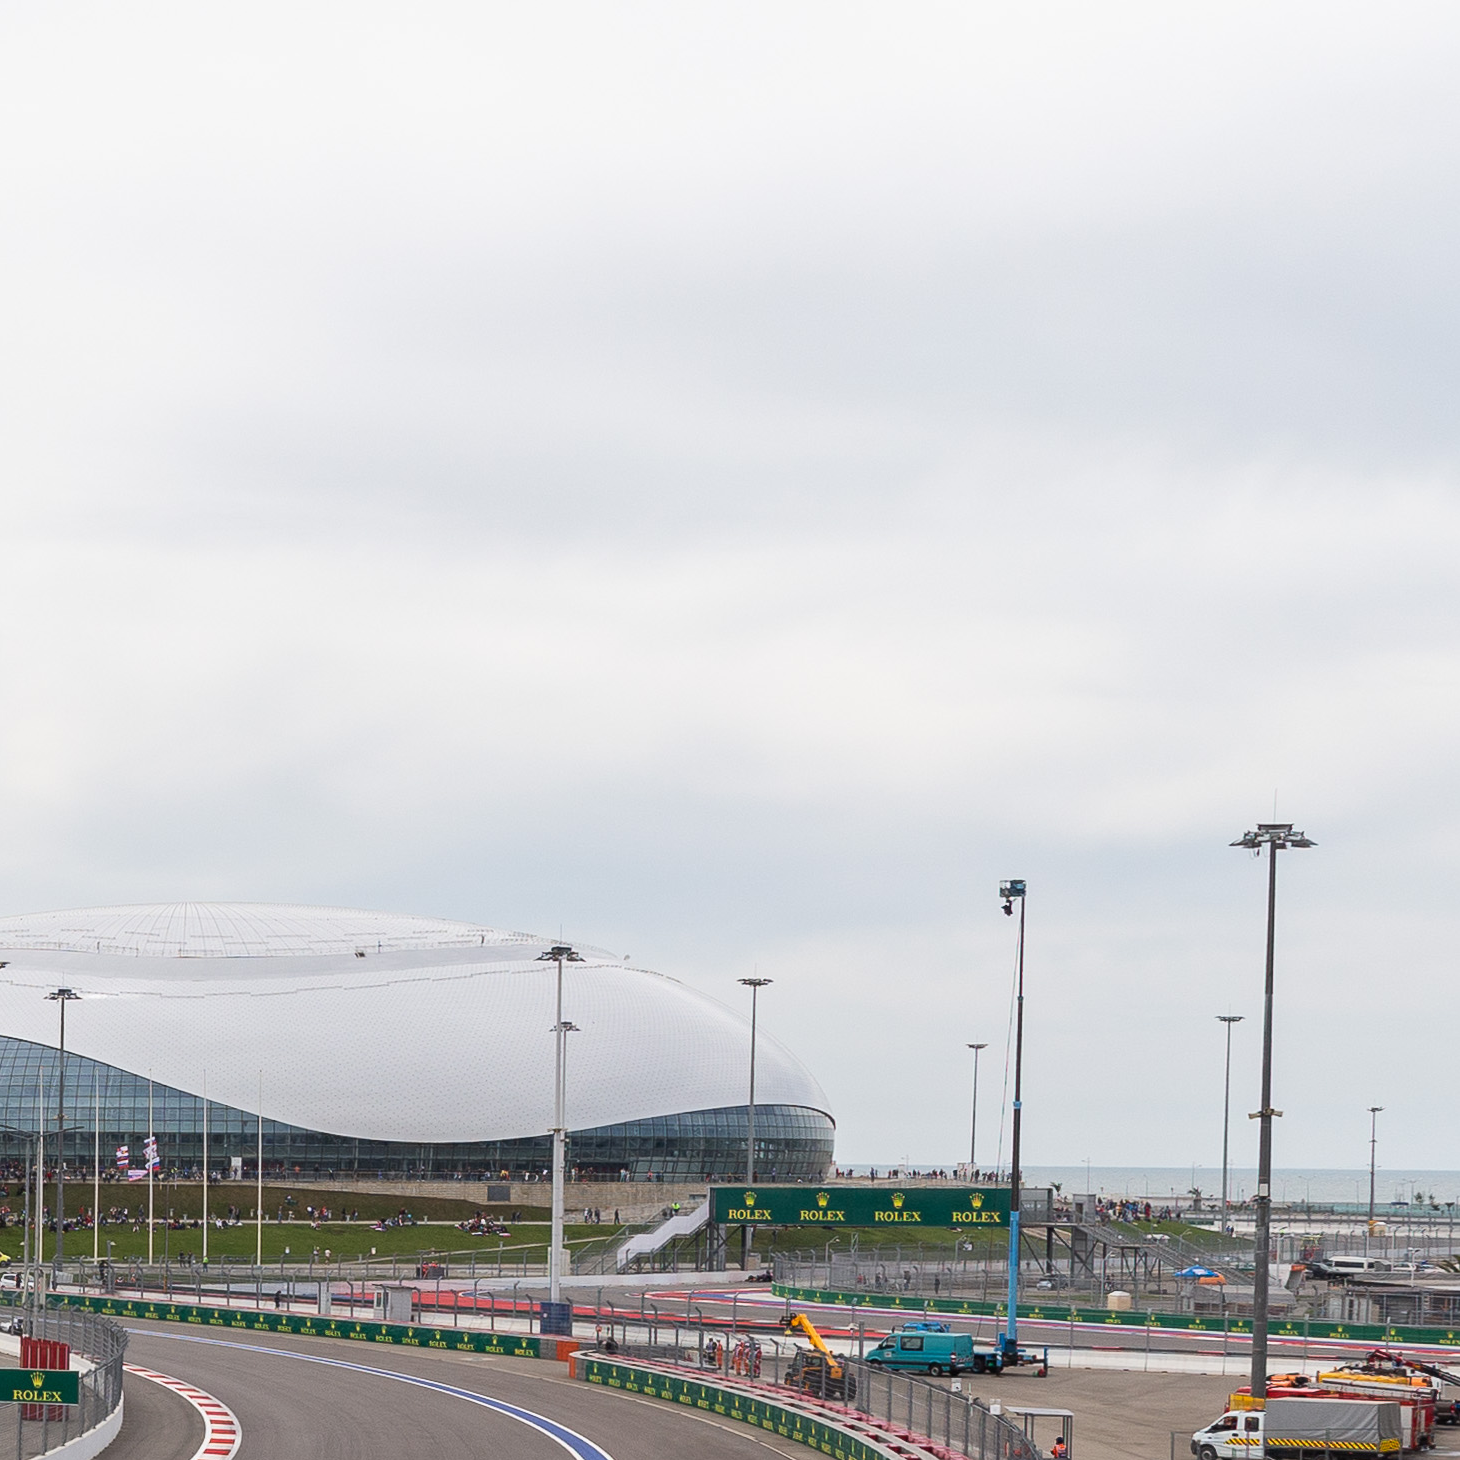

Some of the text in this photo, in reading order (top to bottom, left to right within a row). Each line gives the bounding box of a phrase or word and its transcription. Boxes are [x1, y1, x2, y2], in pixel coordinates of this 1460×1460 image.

[728, 1209, 1001, 1222] ROLEX ROLEX ROLEX ROLEX
[13, 1390, 62, 1402] ROLEX
